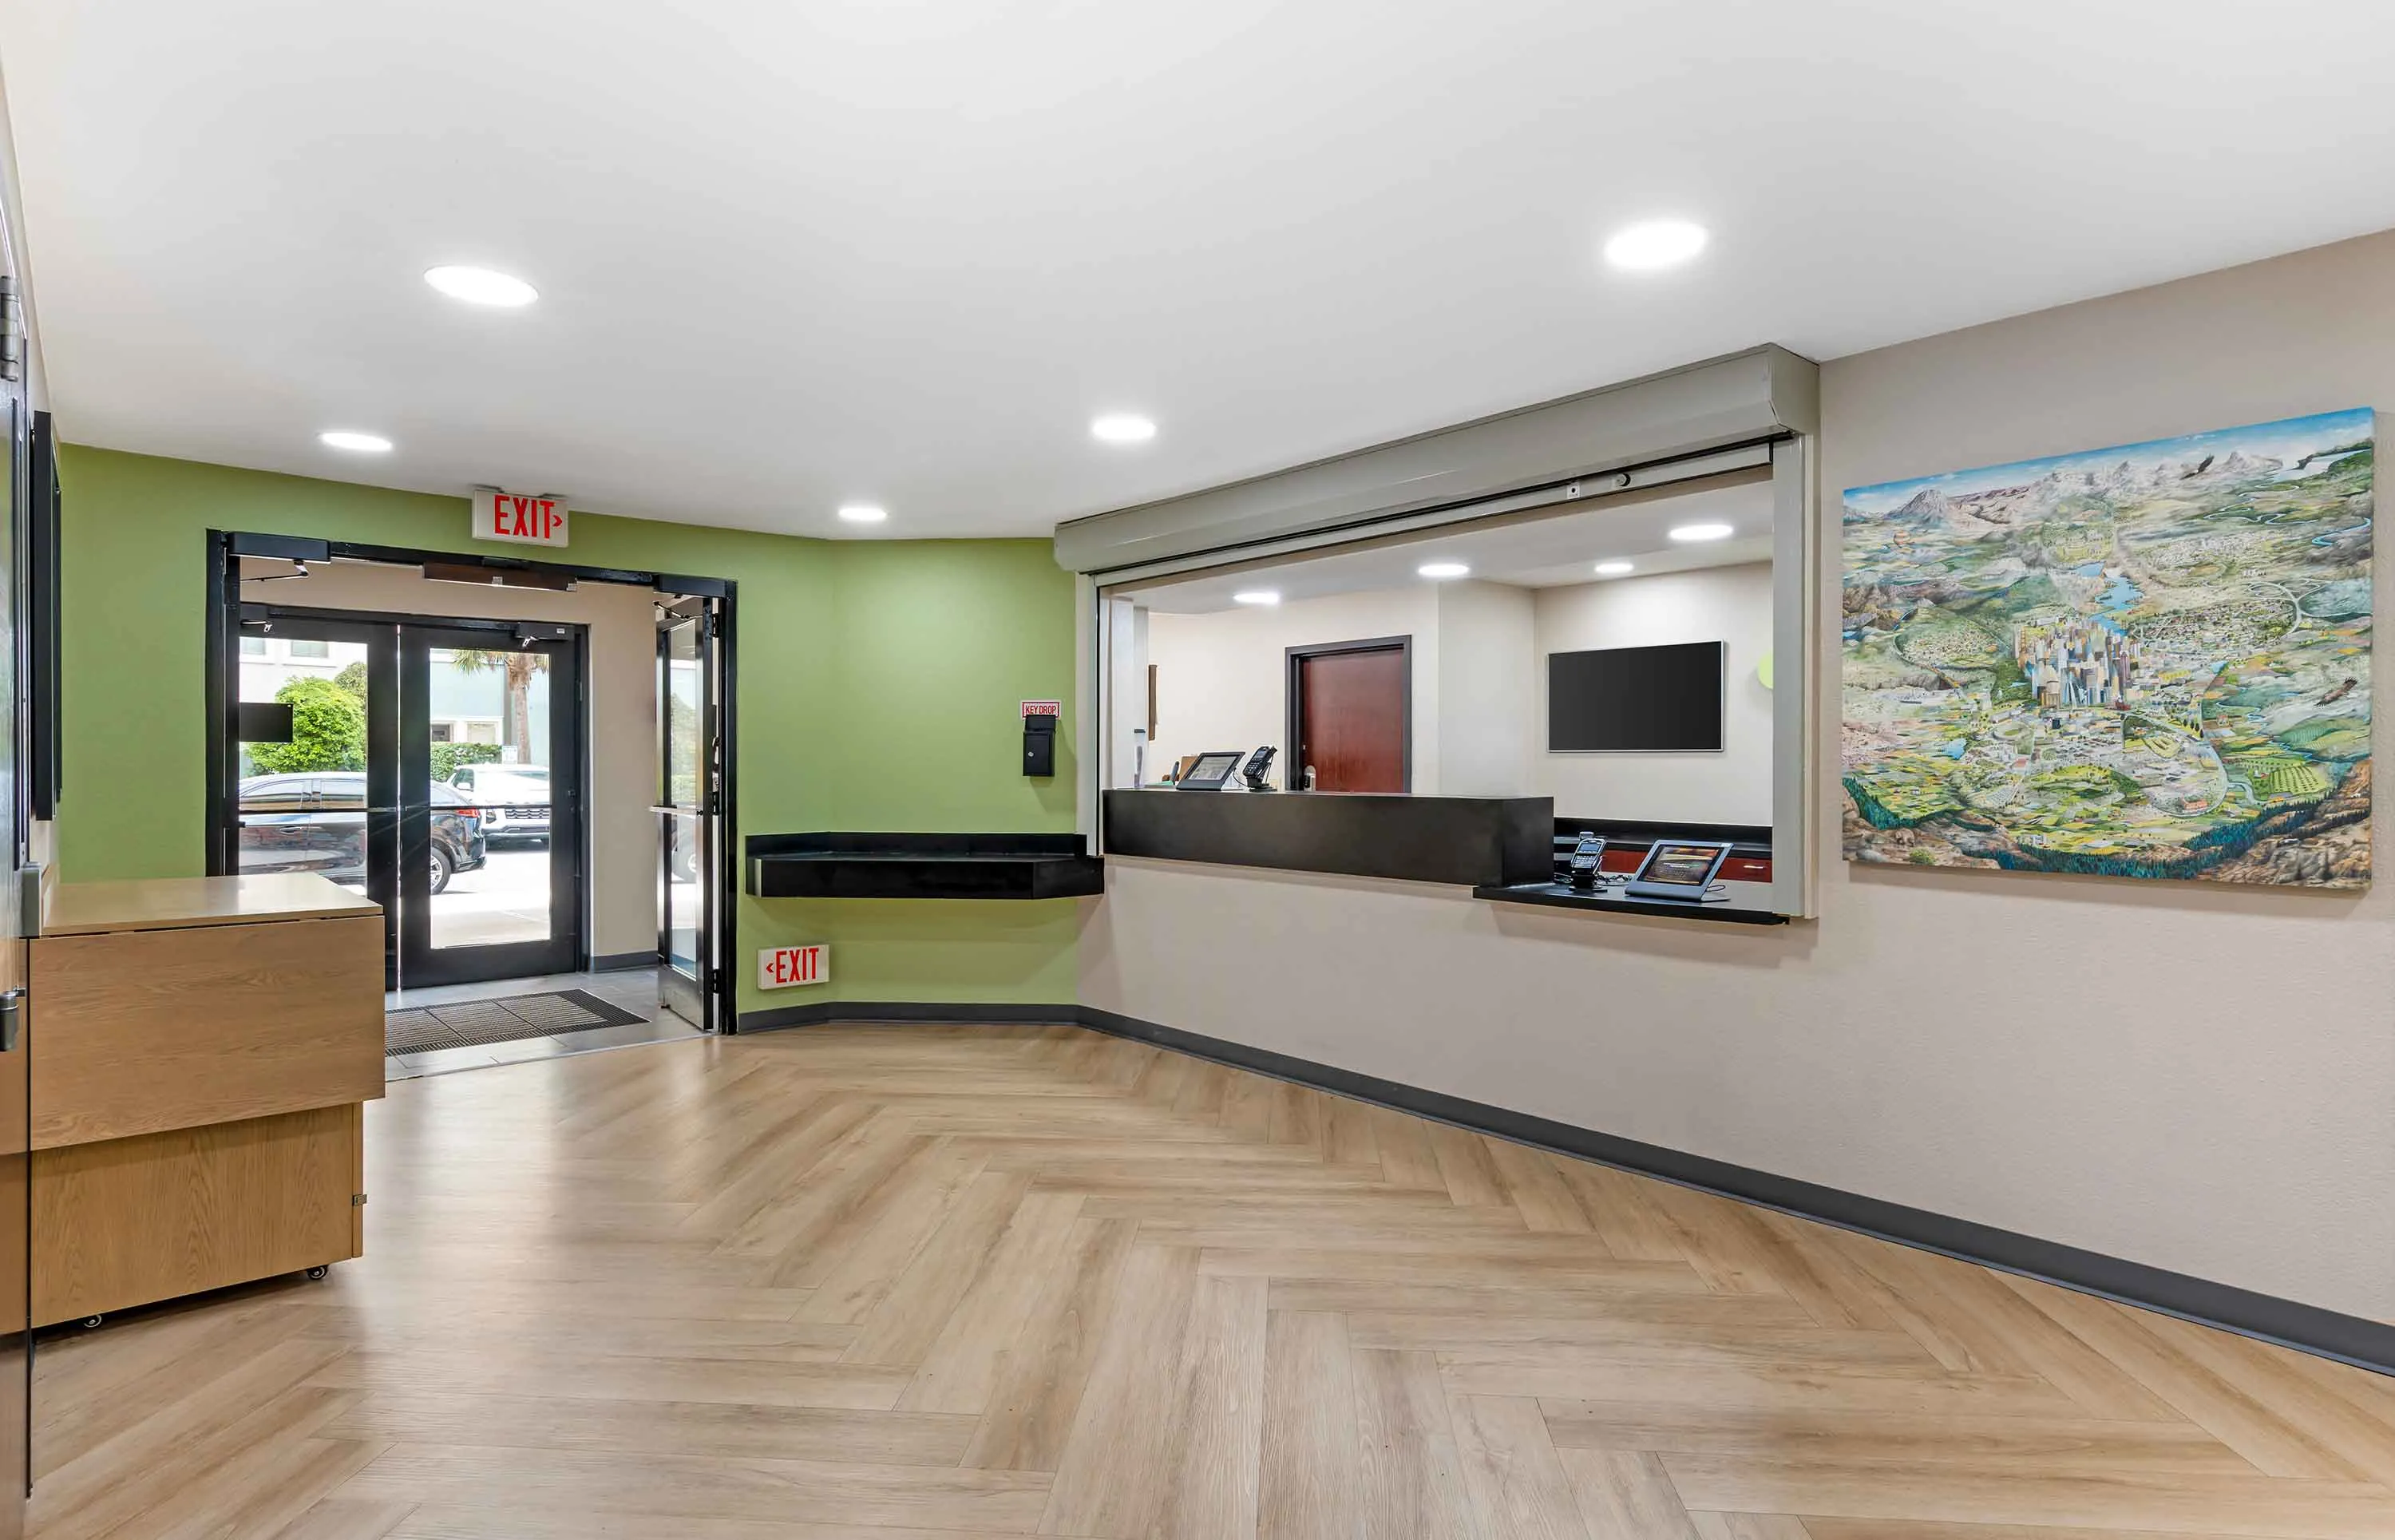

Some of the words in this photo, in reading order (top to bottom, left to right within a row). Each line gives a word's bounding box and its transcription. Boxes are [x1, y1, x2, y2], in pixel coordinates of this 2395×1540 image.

[494, 494, 556, 539] EXIT
[1025, 705, 1038, 715] KEY
[1039, 705, 1056, 715] DROP
[776, 948, 819, 984] EXIT
